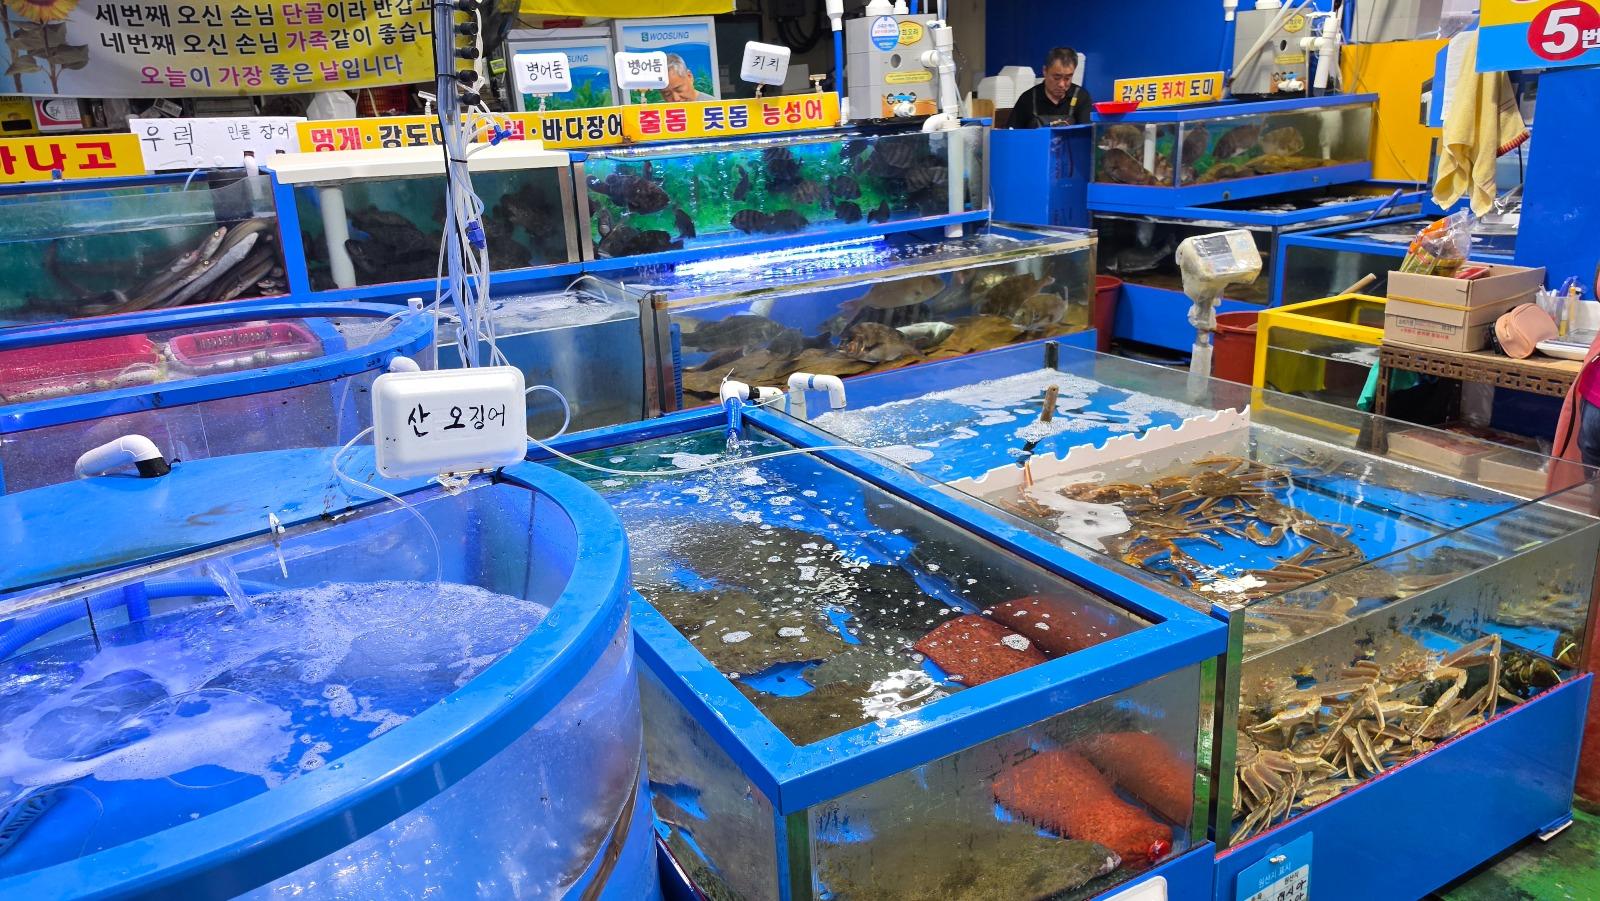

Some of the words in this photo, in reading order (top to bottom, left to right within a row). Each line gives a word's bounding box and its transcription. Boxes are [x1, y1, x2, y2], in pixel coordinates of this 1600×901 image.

[96, 4, 171, 28] 세번째
[178, 4, 223, 27] 오신
[230, 4, 275, 26] 손님
[282, 1, 368, 25] 단골이라
[100, 32, 177, 56] 네번째
[184, 33, 229, 55] 오신
[236, 32, 279, 55] 손님
[286, 26, 372, 52] 가족같이
[140, 66, 211, 88] 오늘이
[218, 66, 263, 87] 가장
[269, 63, 314, 85] 좋은
[320, 54, 403, 82] 날입니다
[1161, 80, 1186, 100] 쥐치
[1189, 78, 1214, 97] 도미
[639, 108, 688, 135] 줄돔
[704, 104, 749, 131] 돗돔
[763, 98, 823, 126] 능성어
[407, 403, 432, 438] 산
[443, 404, 506, 431] 오징어
